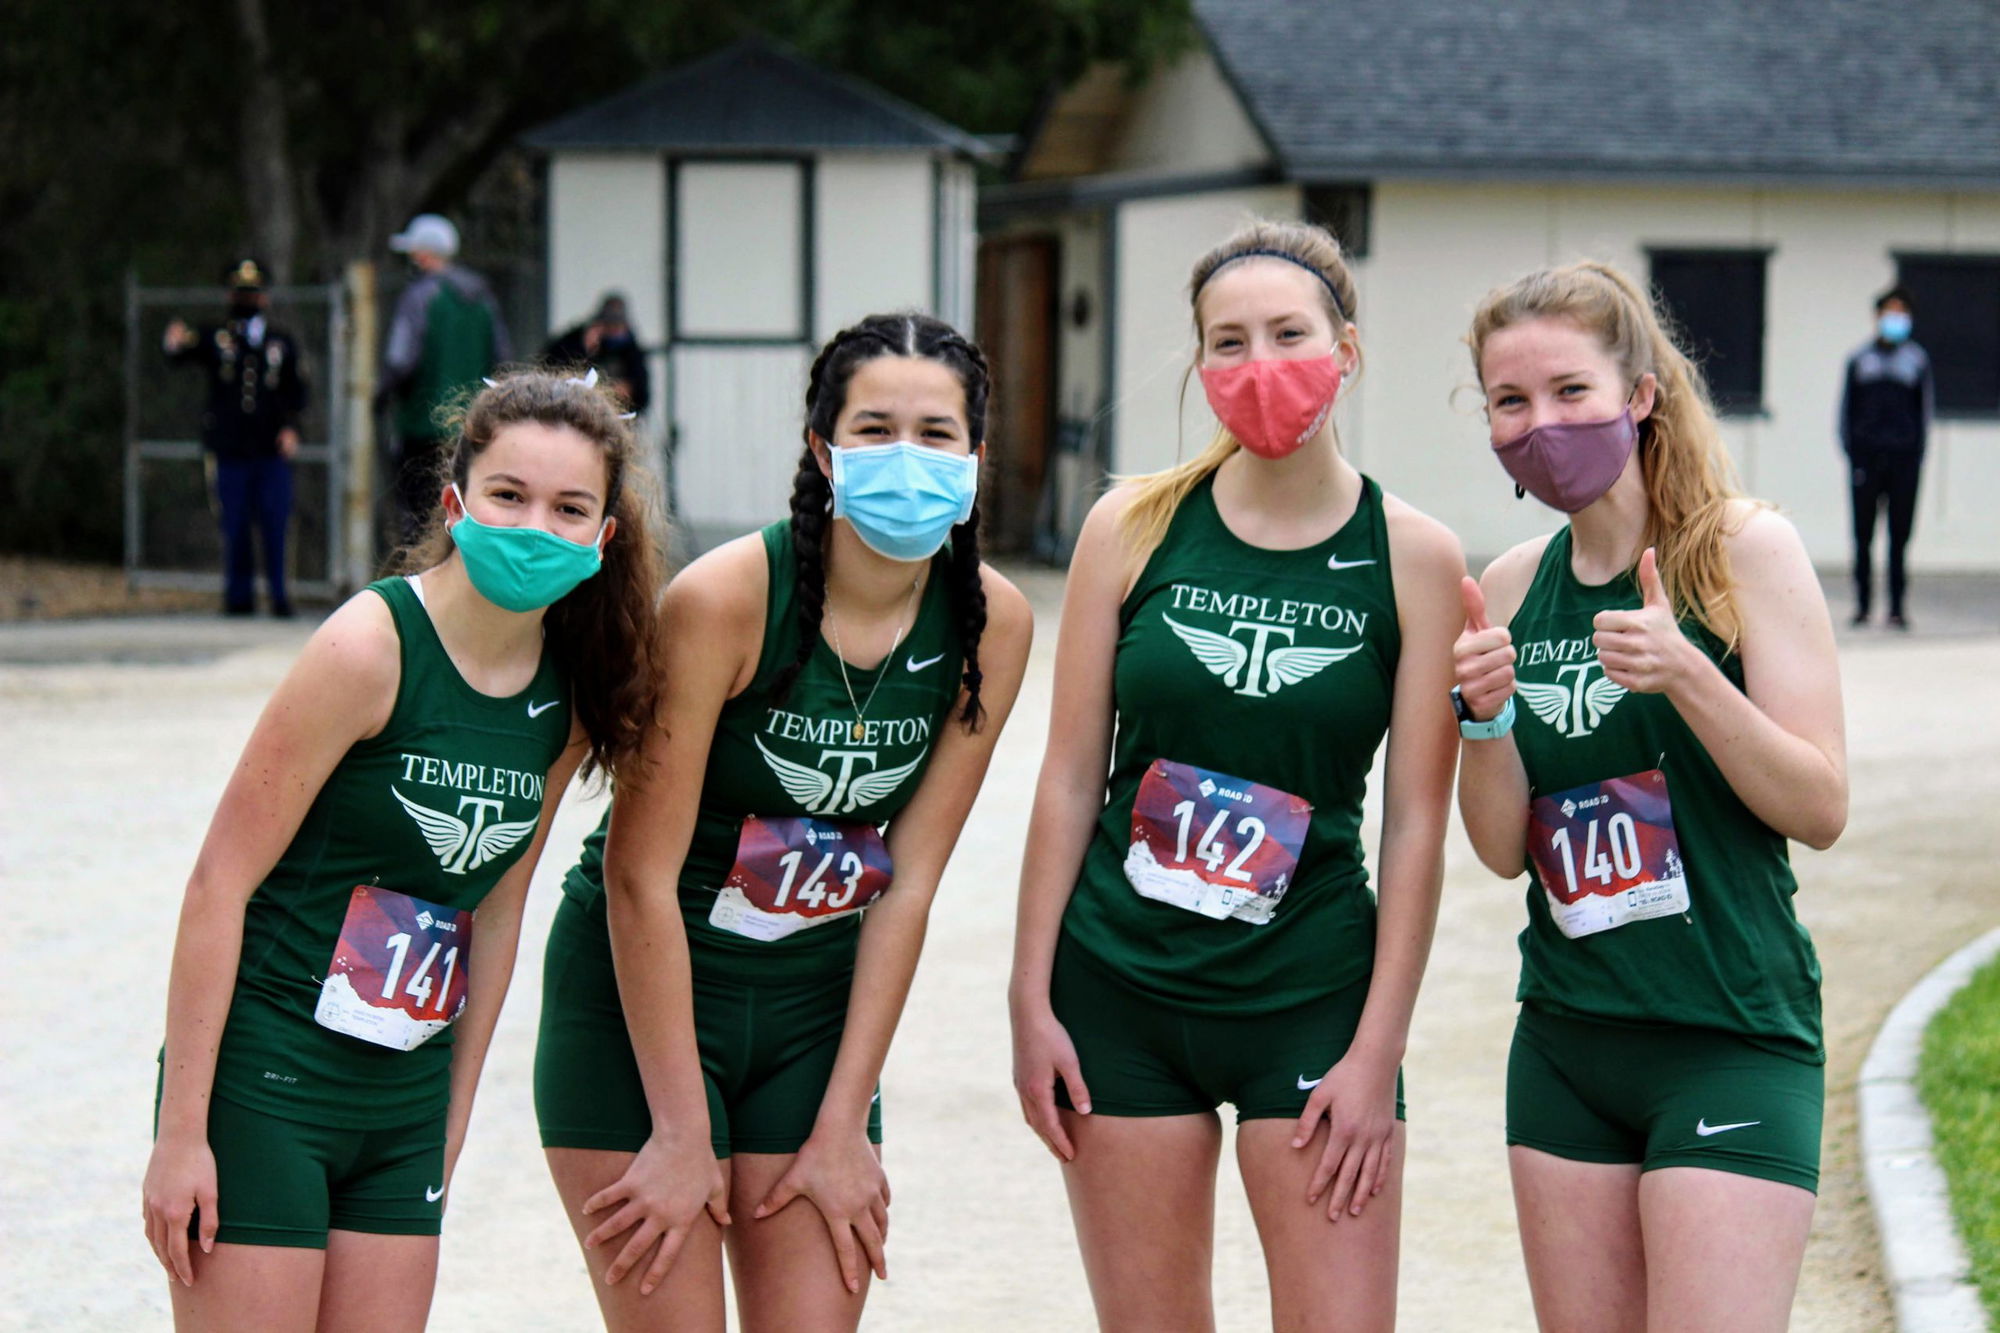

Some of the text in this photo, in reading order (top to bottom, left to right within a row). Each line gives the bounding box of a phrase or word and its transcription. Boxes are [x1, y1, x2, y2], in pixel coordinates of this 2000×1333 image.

[1171, 584, 1369, 637] TEMPLETON
[1519, 635, 1600, 669] TEMPL
[766, 707, 932, 746] TEMPLETON
[401, 753, 545, 802] TEMPLETON
[1218, 787, 1243, 801] ROAD
[1578, 797, 1600, 810] ROAD
[1173, 799, 1267, 883] 142
[1551, 812, 1643, 894] 140
[773, 850, 864, 909] 143
[381, 931, 458, 1013] 141
